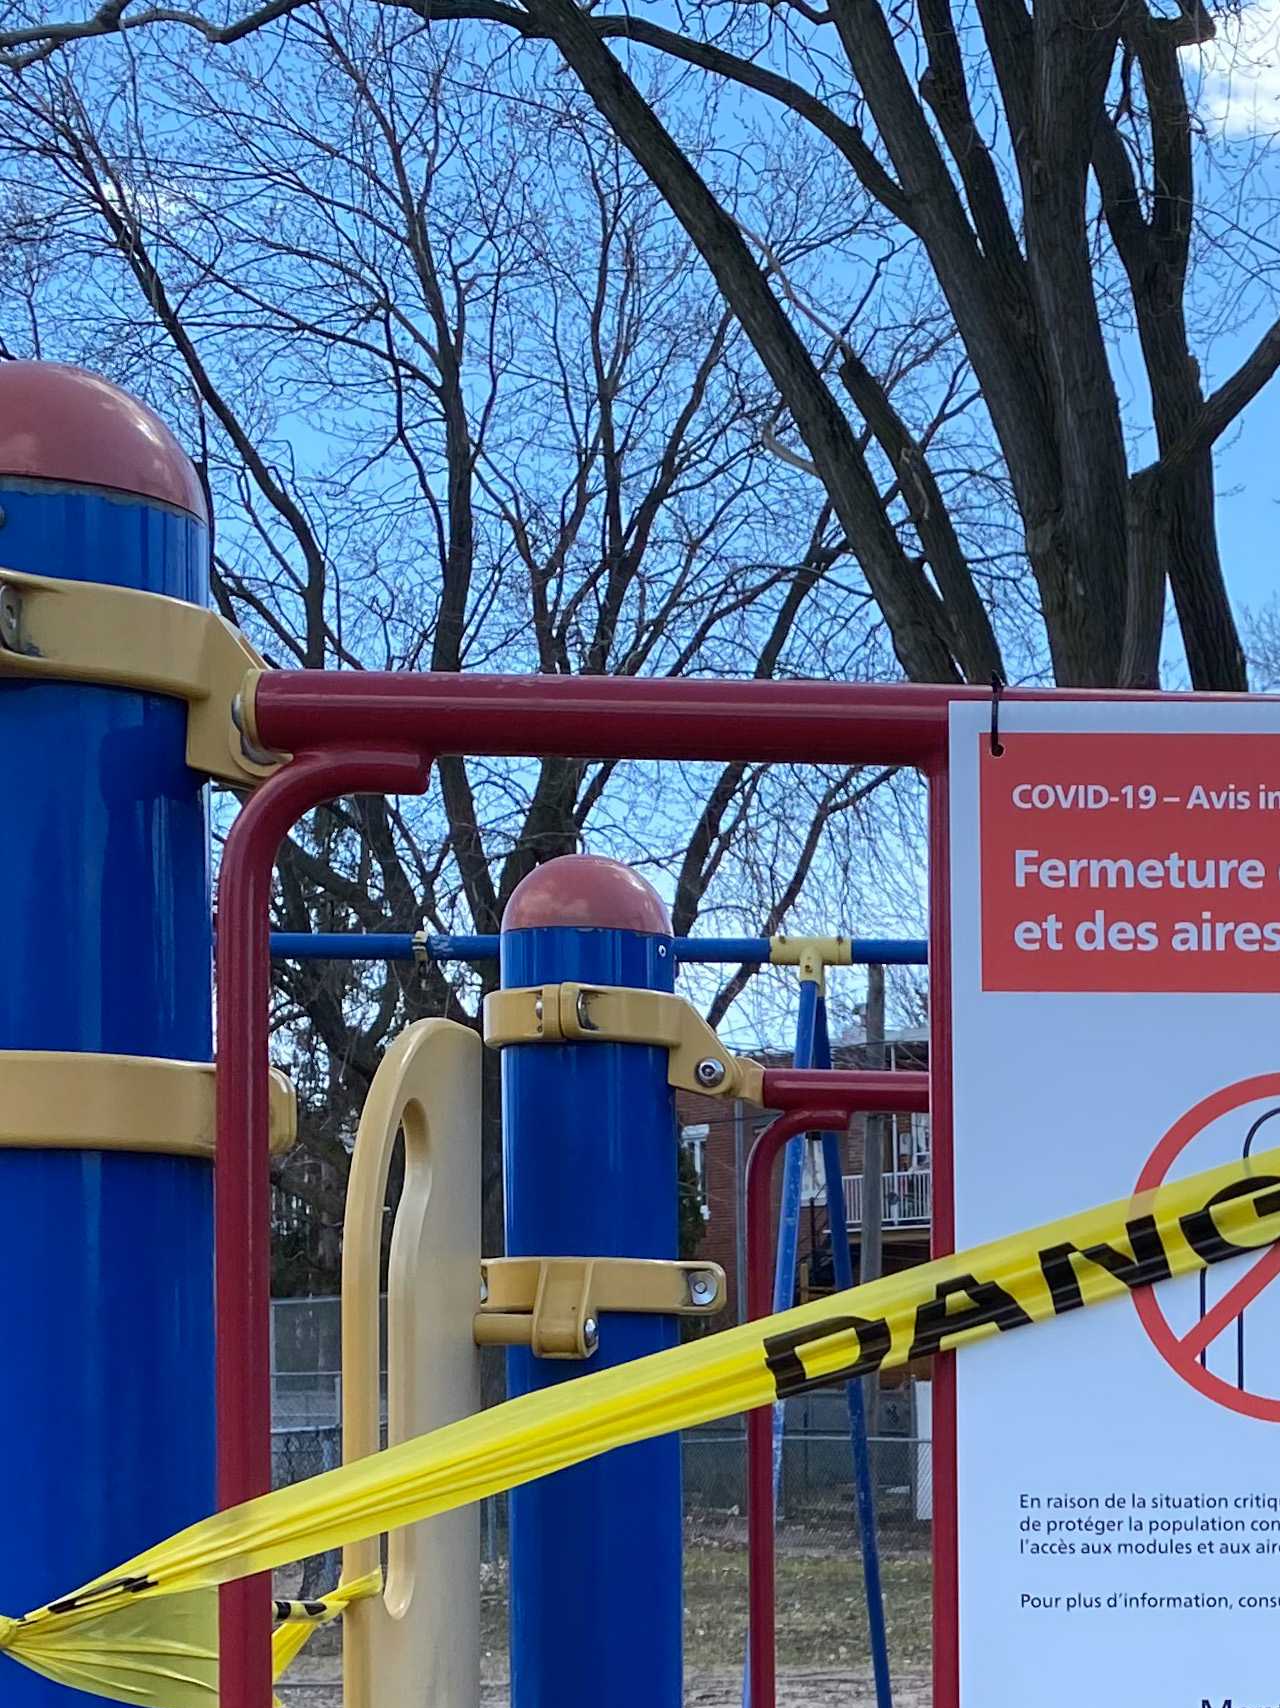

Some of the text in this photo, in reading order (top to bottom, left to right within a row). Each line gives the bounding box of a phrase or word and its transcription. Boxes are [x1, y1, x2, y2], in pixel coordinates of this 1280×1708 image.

[1012, 783, 1157, 810] COVID-19
[1186, 783, 1251, 810] Avis
[1015, 849, 1266, 889] Fermeture
[1014, 913, 1064, 951] et
[1074, 909, 1159, 952] des
[1020, 1493, 1041, 1509] En
[1046, 1493, 1100, 1509] raison
[1104, 1493, 1127, 1509] de
[1131, 1493, 1147, 1509] la
[1151, 1493, 1229, 1509] situation
[1019, 1515, 1042, 1532] de
[1046, 1515, 1124, 1536] protéger
[1128, 1515, 1144, 1532] la
[1148, 1515, 1246, 1536] population
[1080, 1542, 1113, 1555] aux
[1117, 1538, 1193, 1555] modules
[1197, 1540, 1215, 1555] et
[1219, 1542, 1251, 1555] aux
[1020, 1592, 1062, 1609] Pour
[1065, 1592, 1102, 1612] plus
